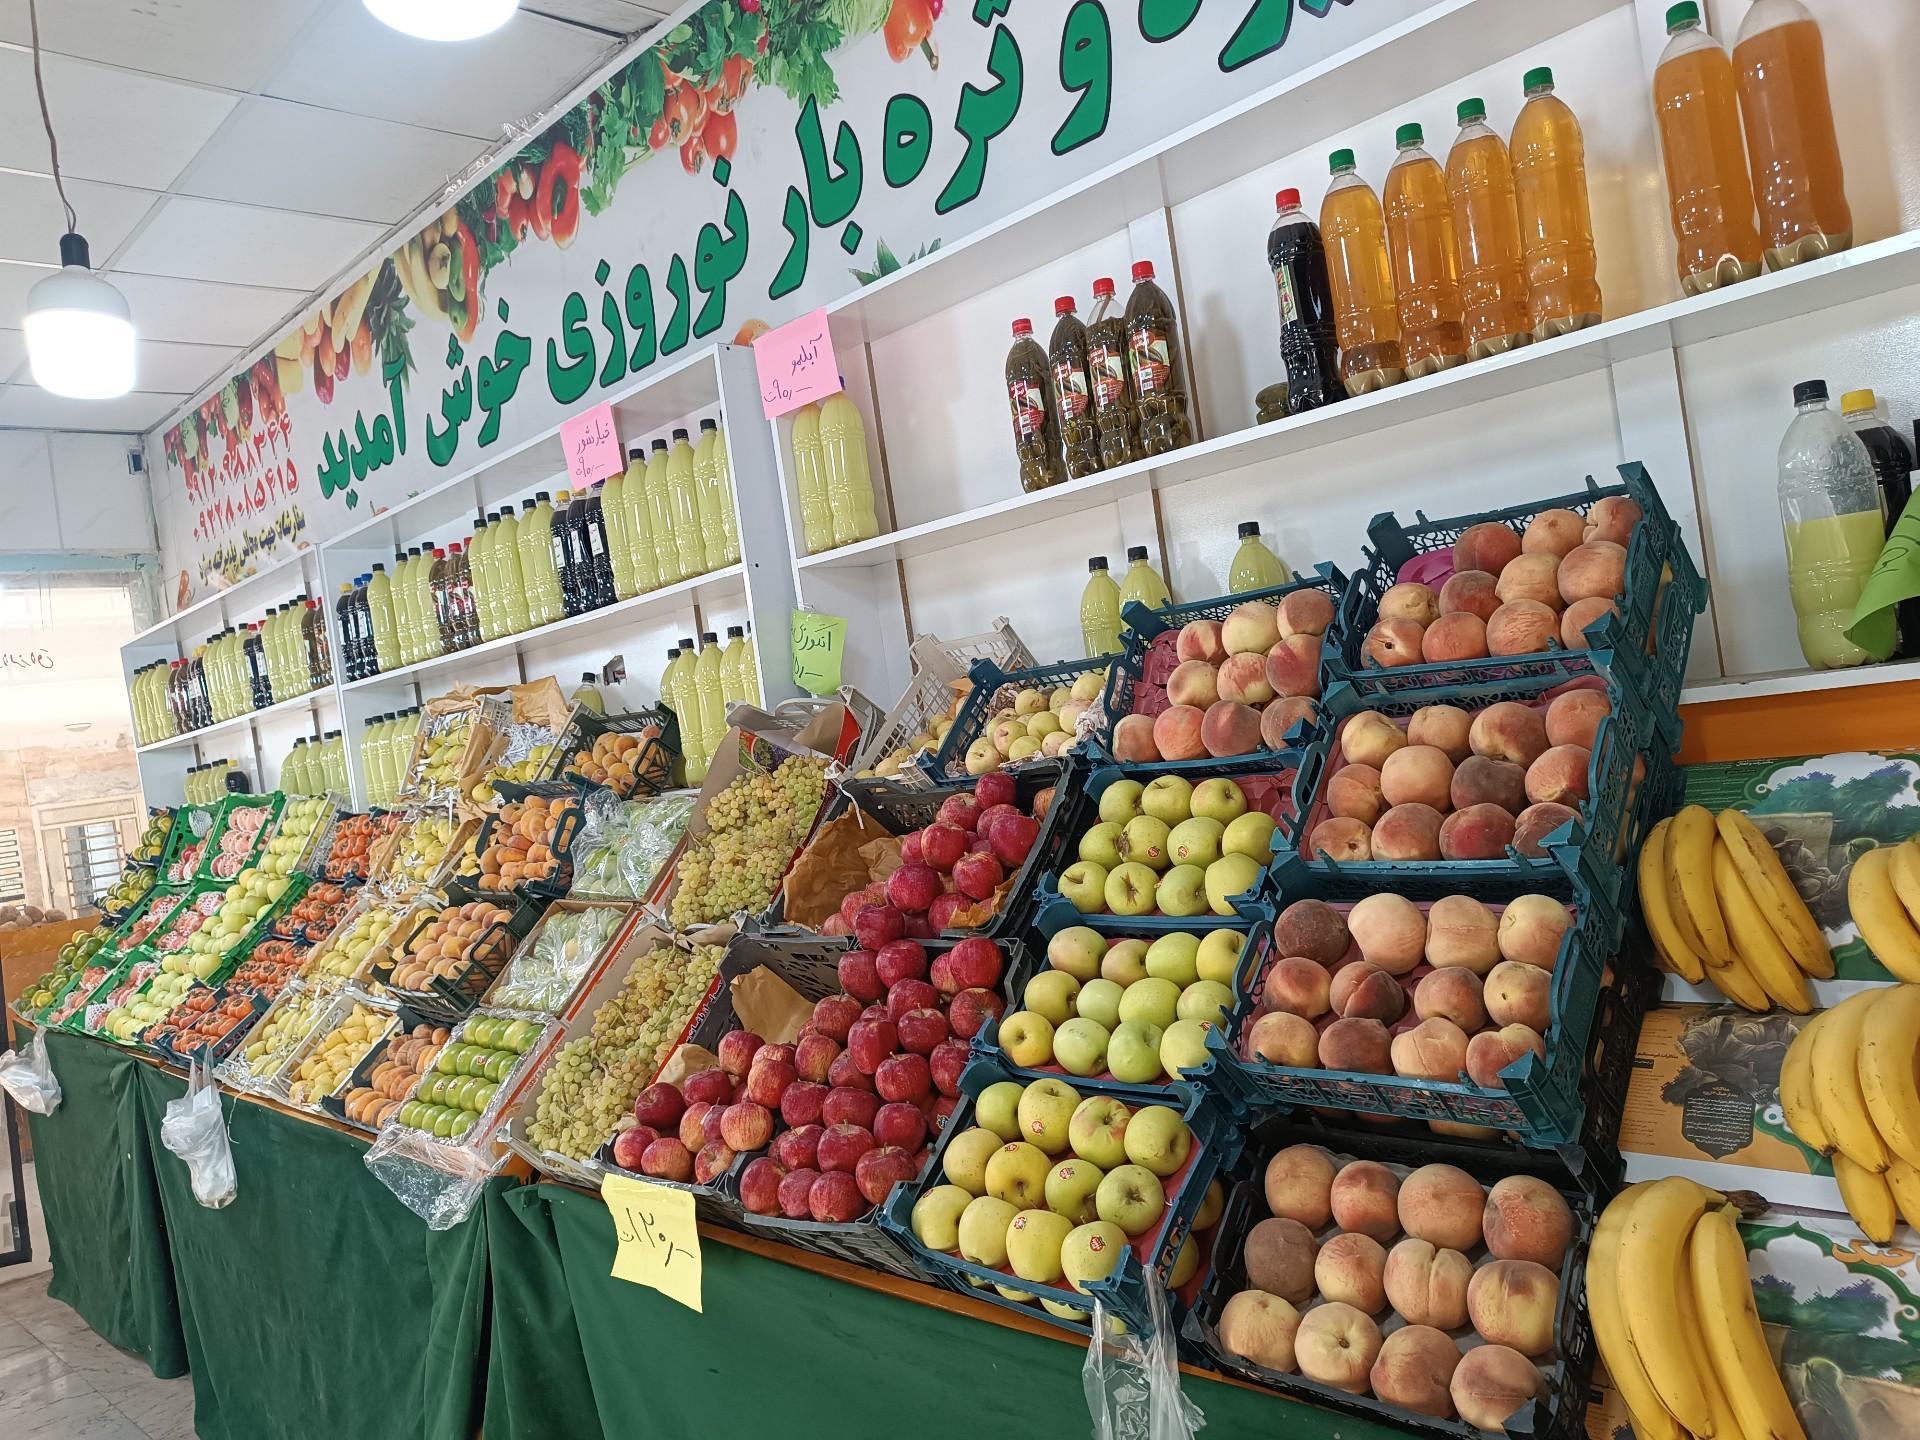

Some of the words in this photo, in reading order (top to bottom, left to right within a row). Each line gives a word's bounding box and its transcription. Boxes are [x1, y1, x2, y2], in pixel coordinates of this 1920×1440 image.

[883, 0, 1023, 215] تره
[1051, 0, 1113, 155] و
[547, 155, 749, 405] نوروزی
[770, 94, 863, 300] بار
[317, 354, 407, 510] آمدید
[426, 297, 532, 467] خوش
[791, 333, 823, 376] آبلیمو
